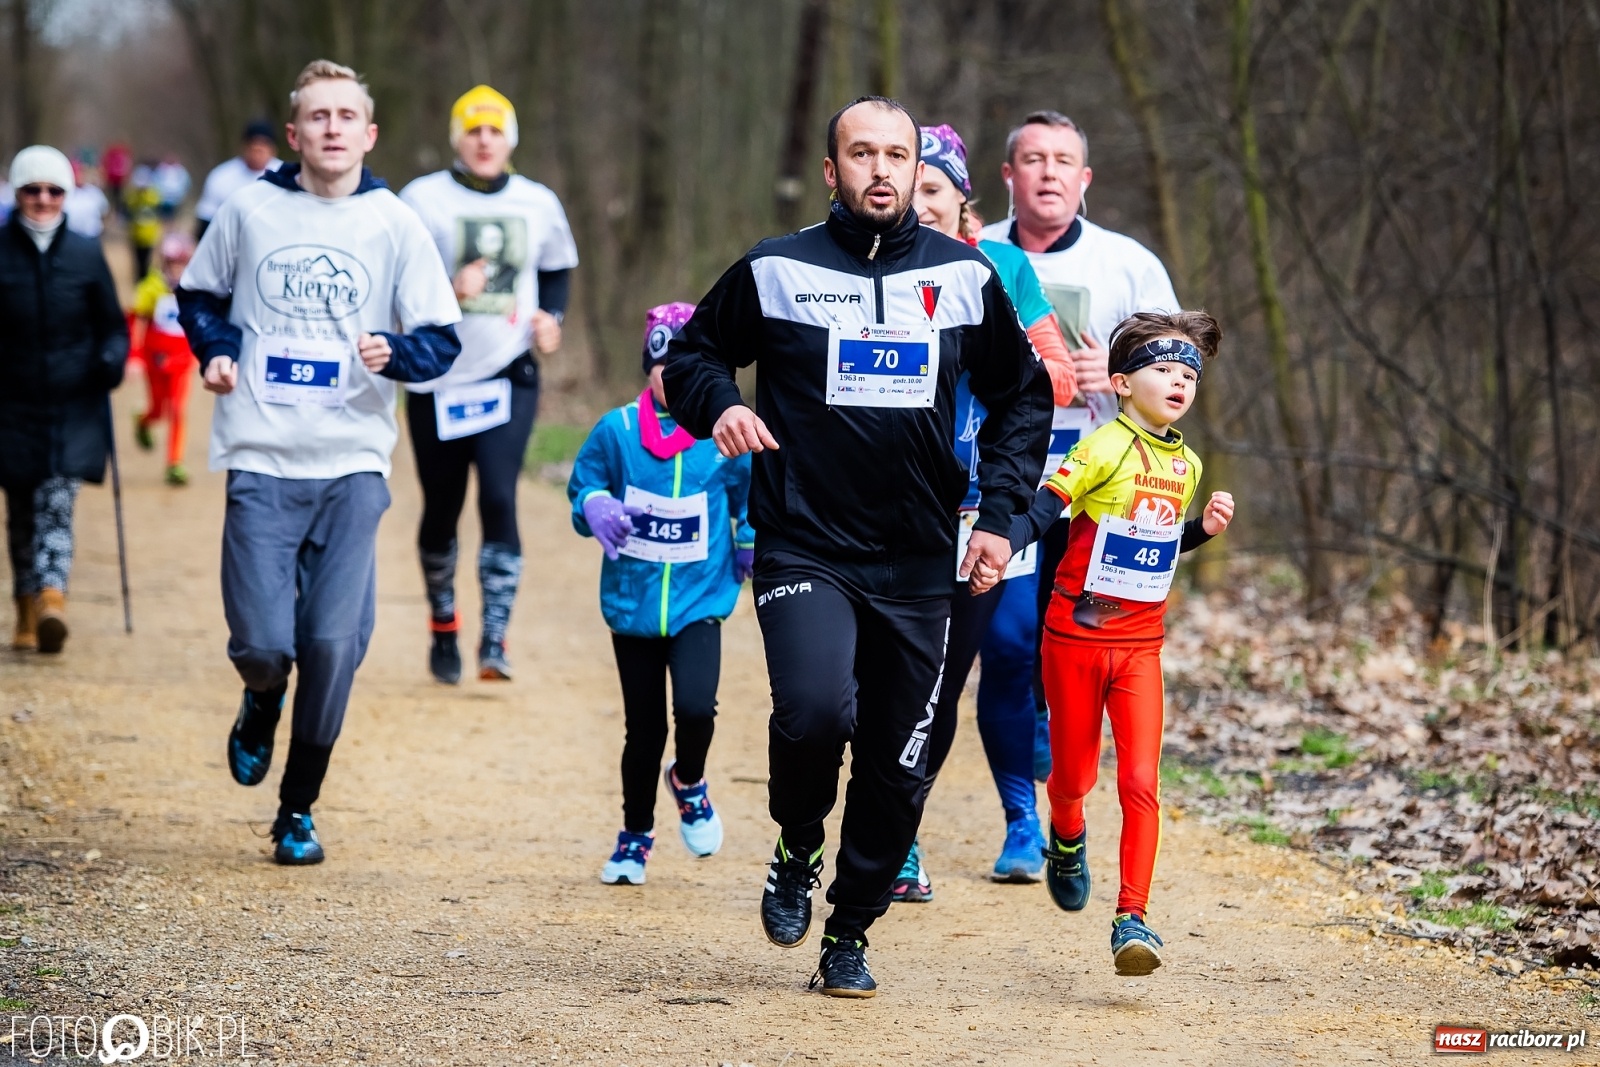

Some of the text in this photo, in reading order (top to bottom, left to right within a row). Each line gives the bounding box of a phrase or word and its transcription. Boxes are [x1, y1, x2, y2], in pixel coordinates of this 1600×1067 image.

[282, 274, 358, 306] Kierpce
[795, 293, 861, 304] GIVOVA
[872, 348, 899, 369] 70
[1155, 352, 1180, 362] MORS
[290, 363, 315, 383] 59
[839, 374, 857, 382] 1963
[1134, 473, 1185, 496] RACIBORKI
[647, 520, 682, 540] 145
[1133, 547, 1161, 567] 48
[1101, 564, 1118, 574] 1963
[758, 582, 812, 607] GIVOVA
